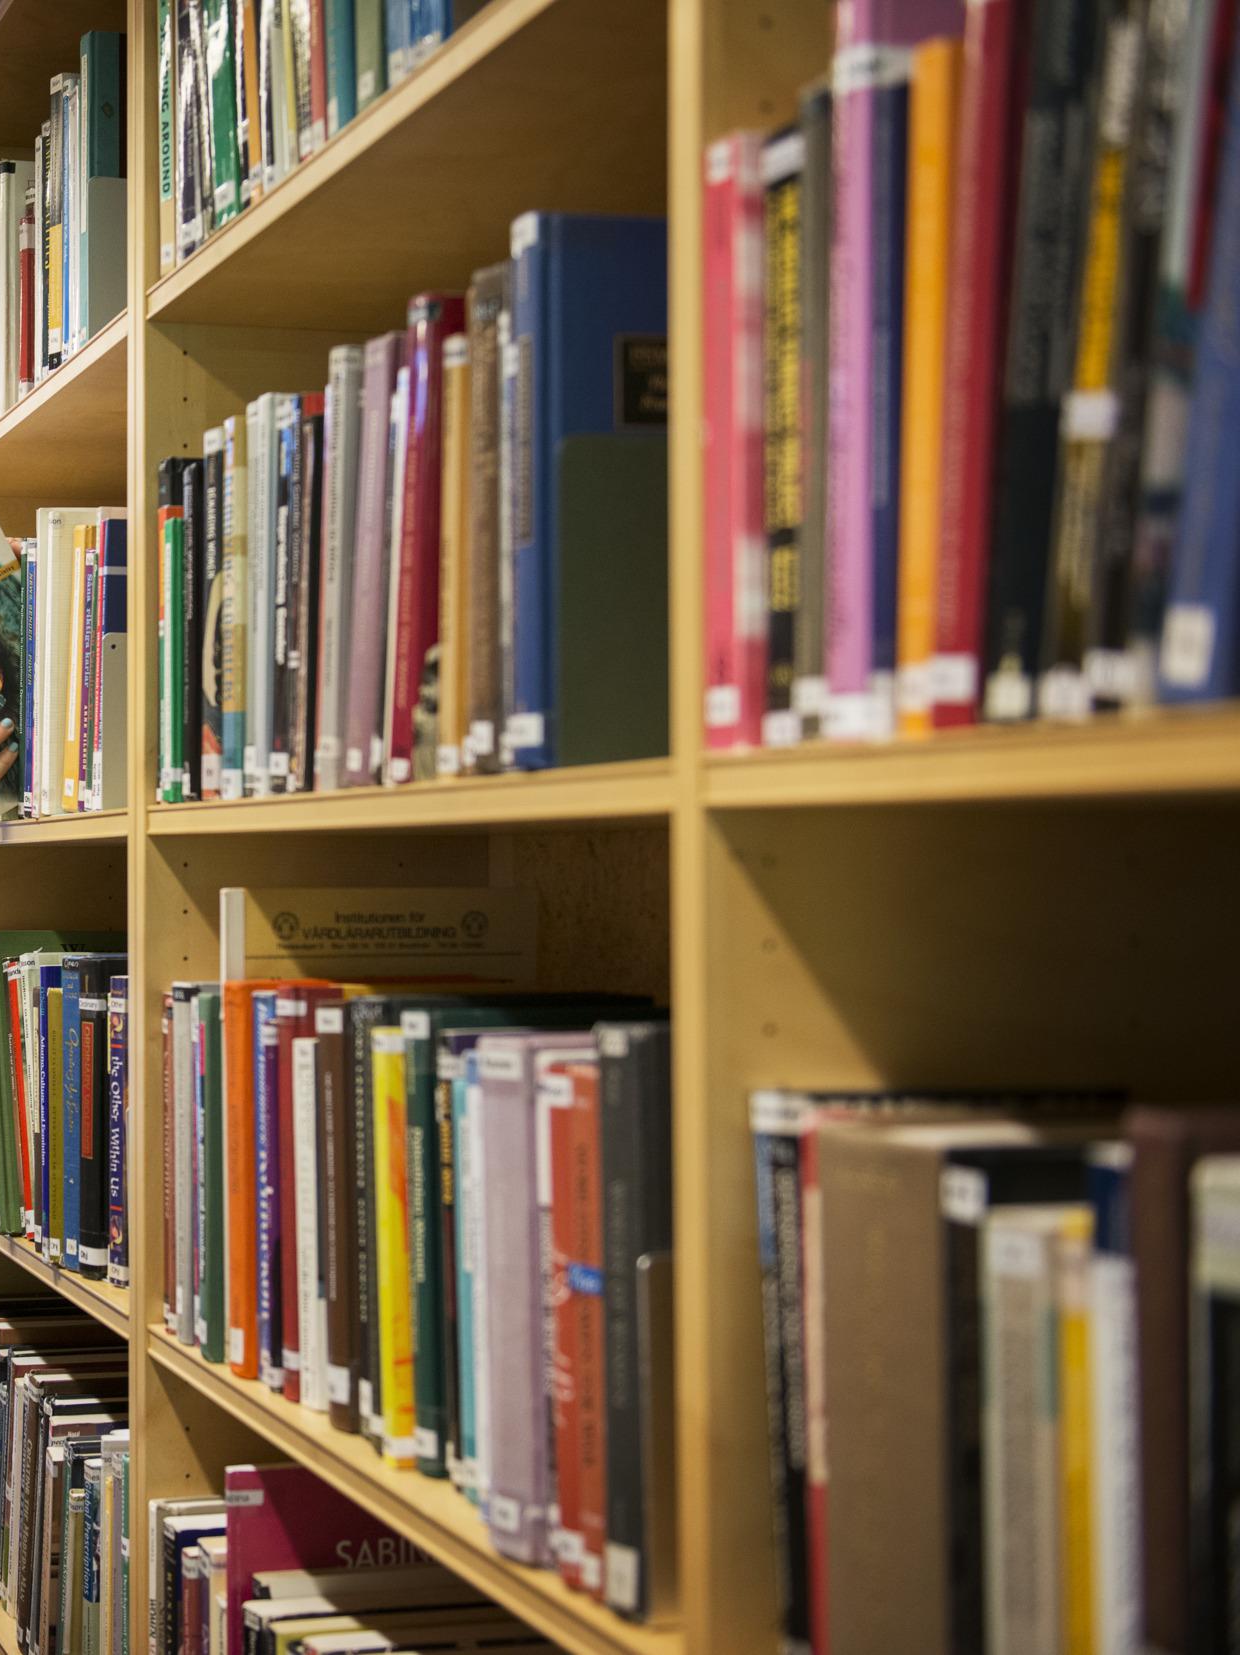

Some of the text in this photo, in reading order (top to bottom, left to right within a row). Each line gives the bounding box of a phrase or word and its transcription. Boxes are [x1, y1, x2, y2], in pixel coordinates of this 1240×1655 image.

[161, 121, 170, 194] AROUND
[84, 608, 92, 649] riktiga
[83, 652, 91, 688] karlar
[110, 1056, 124, 1198] the Other Within Us
[25, 1439, 33, 1497] CREATING
[21, 1522, 29, 1573] MODERN
[83, 1480, 93, 1597] Global Prescriptions
